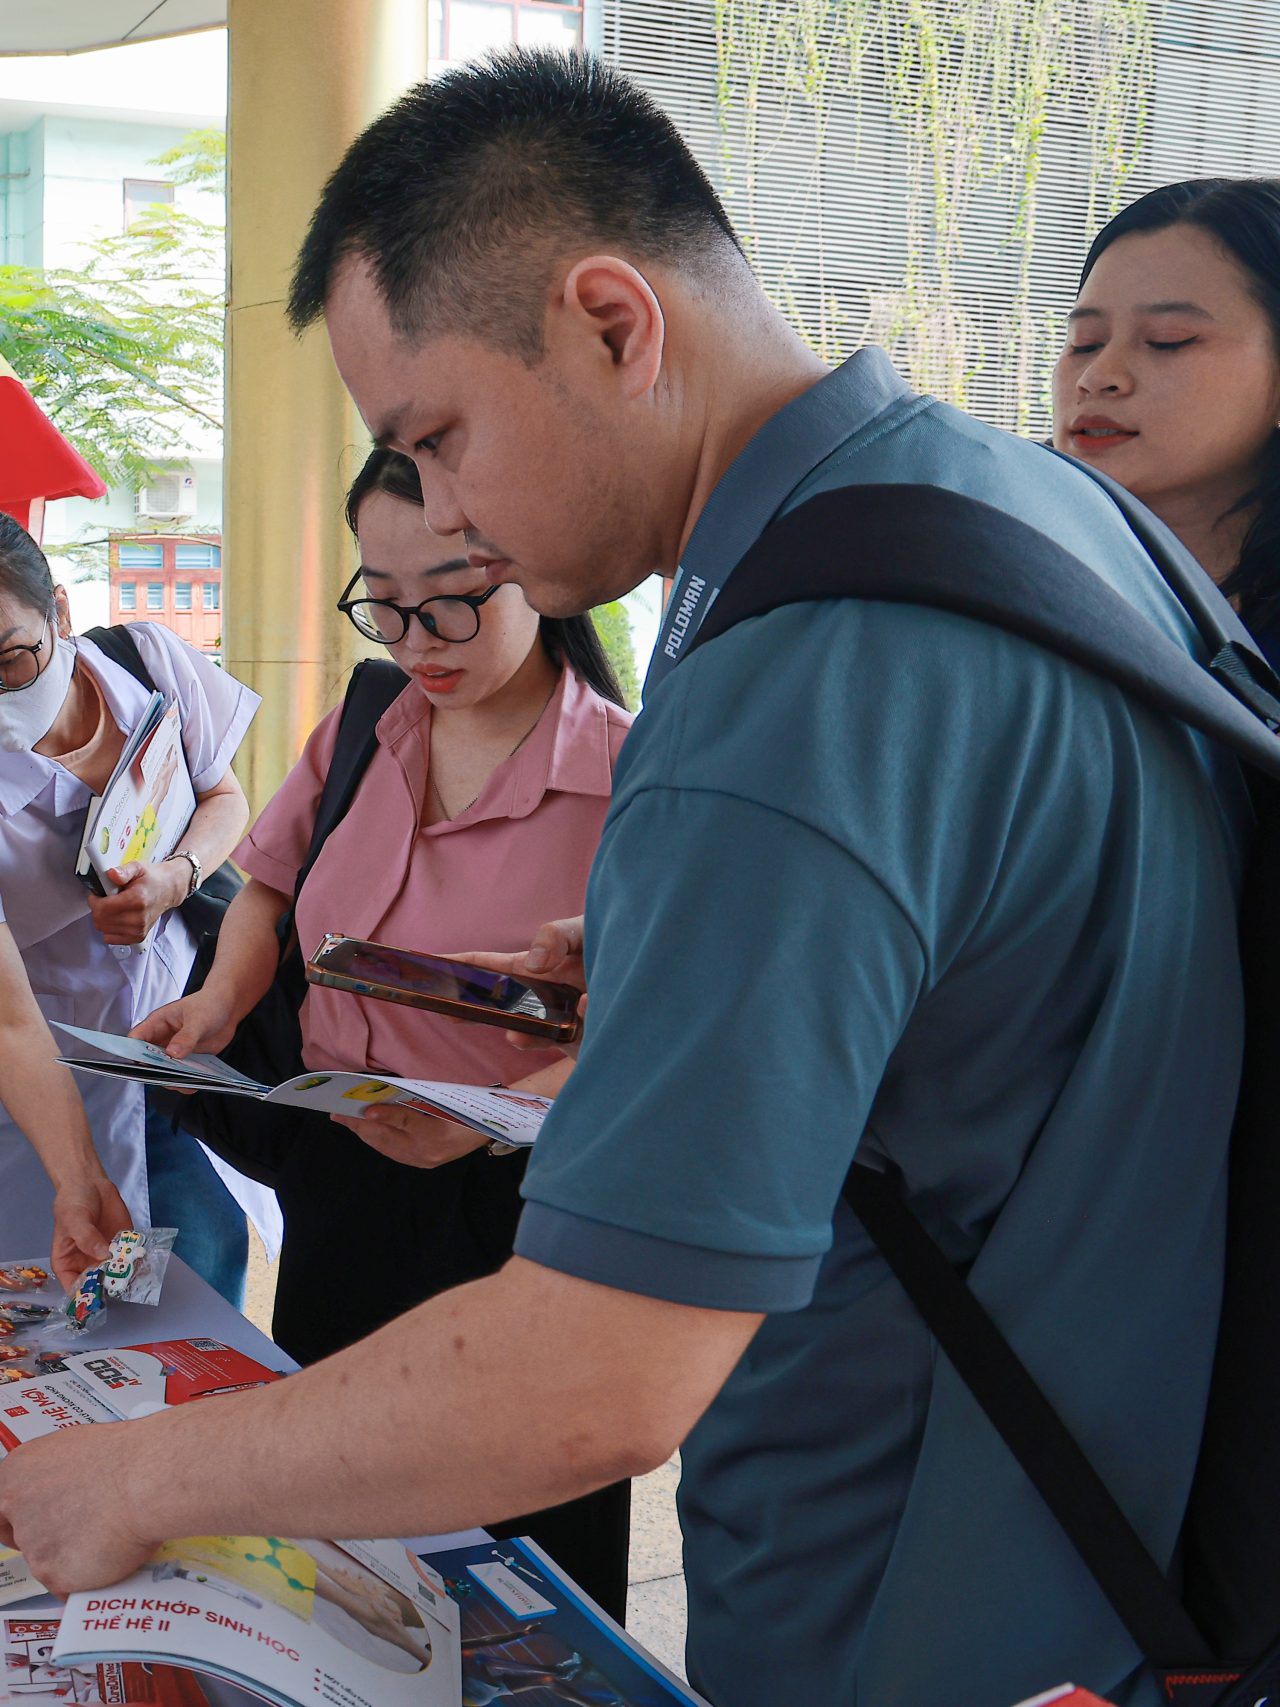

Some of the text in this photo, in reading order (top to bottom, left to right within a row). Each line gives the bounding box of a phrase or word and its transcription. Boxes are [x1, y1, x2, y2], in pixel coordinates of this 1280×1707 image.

[664, 575, 706, 659] POLOMAN
[83, 1613, 170, 1632] THẾ HỆ II
[87, 1598, 300, 1662] DỊCH KHỚP SINH HỌC
